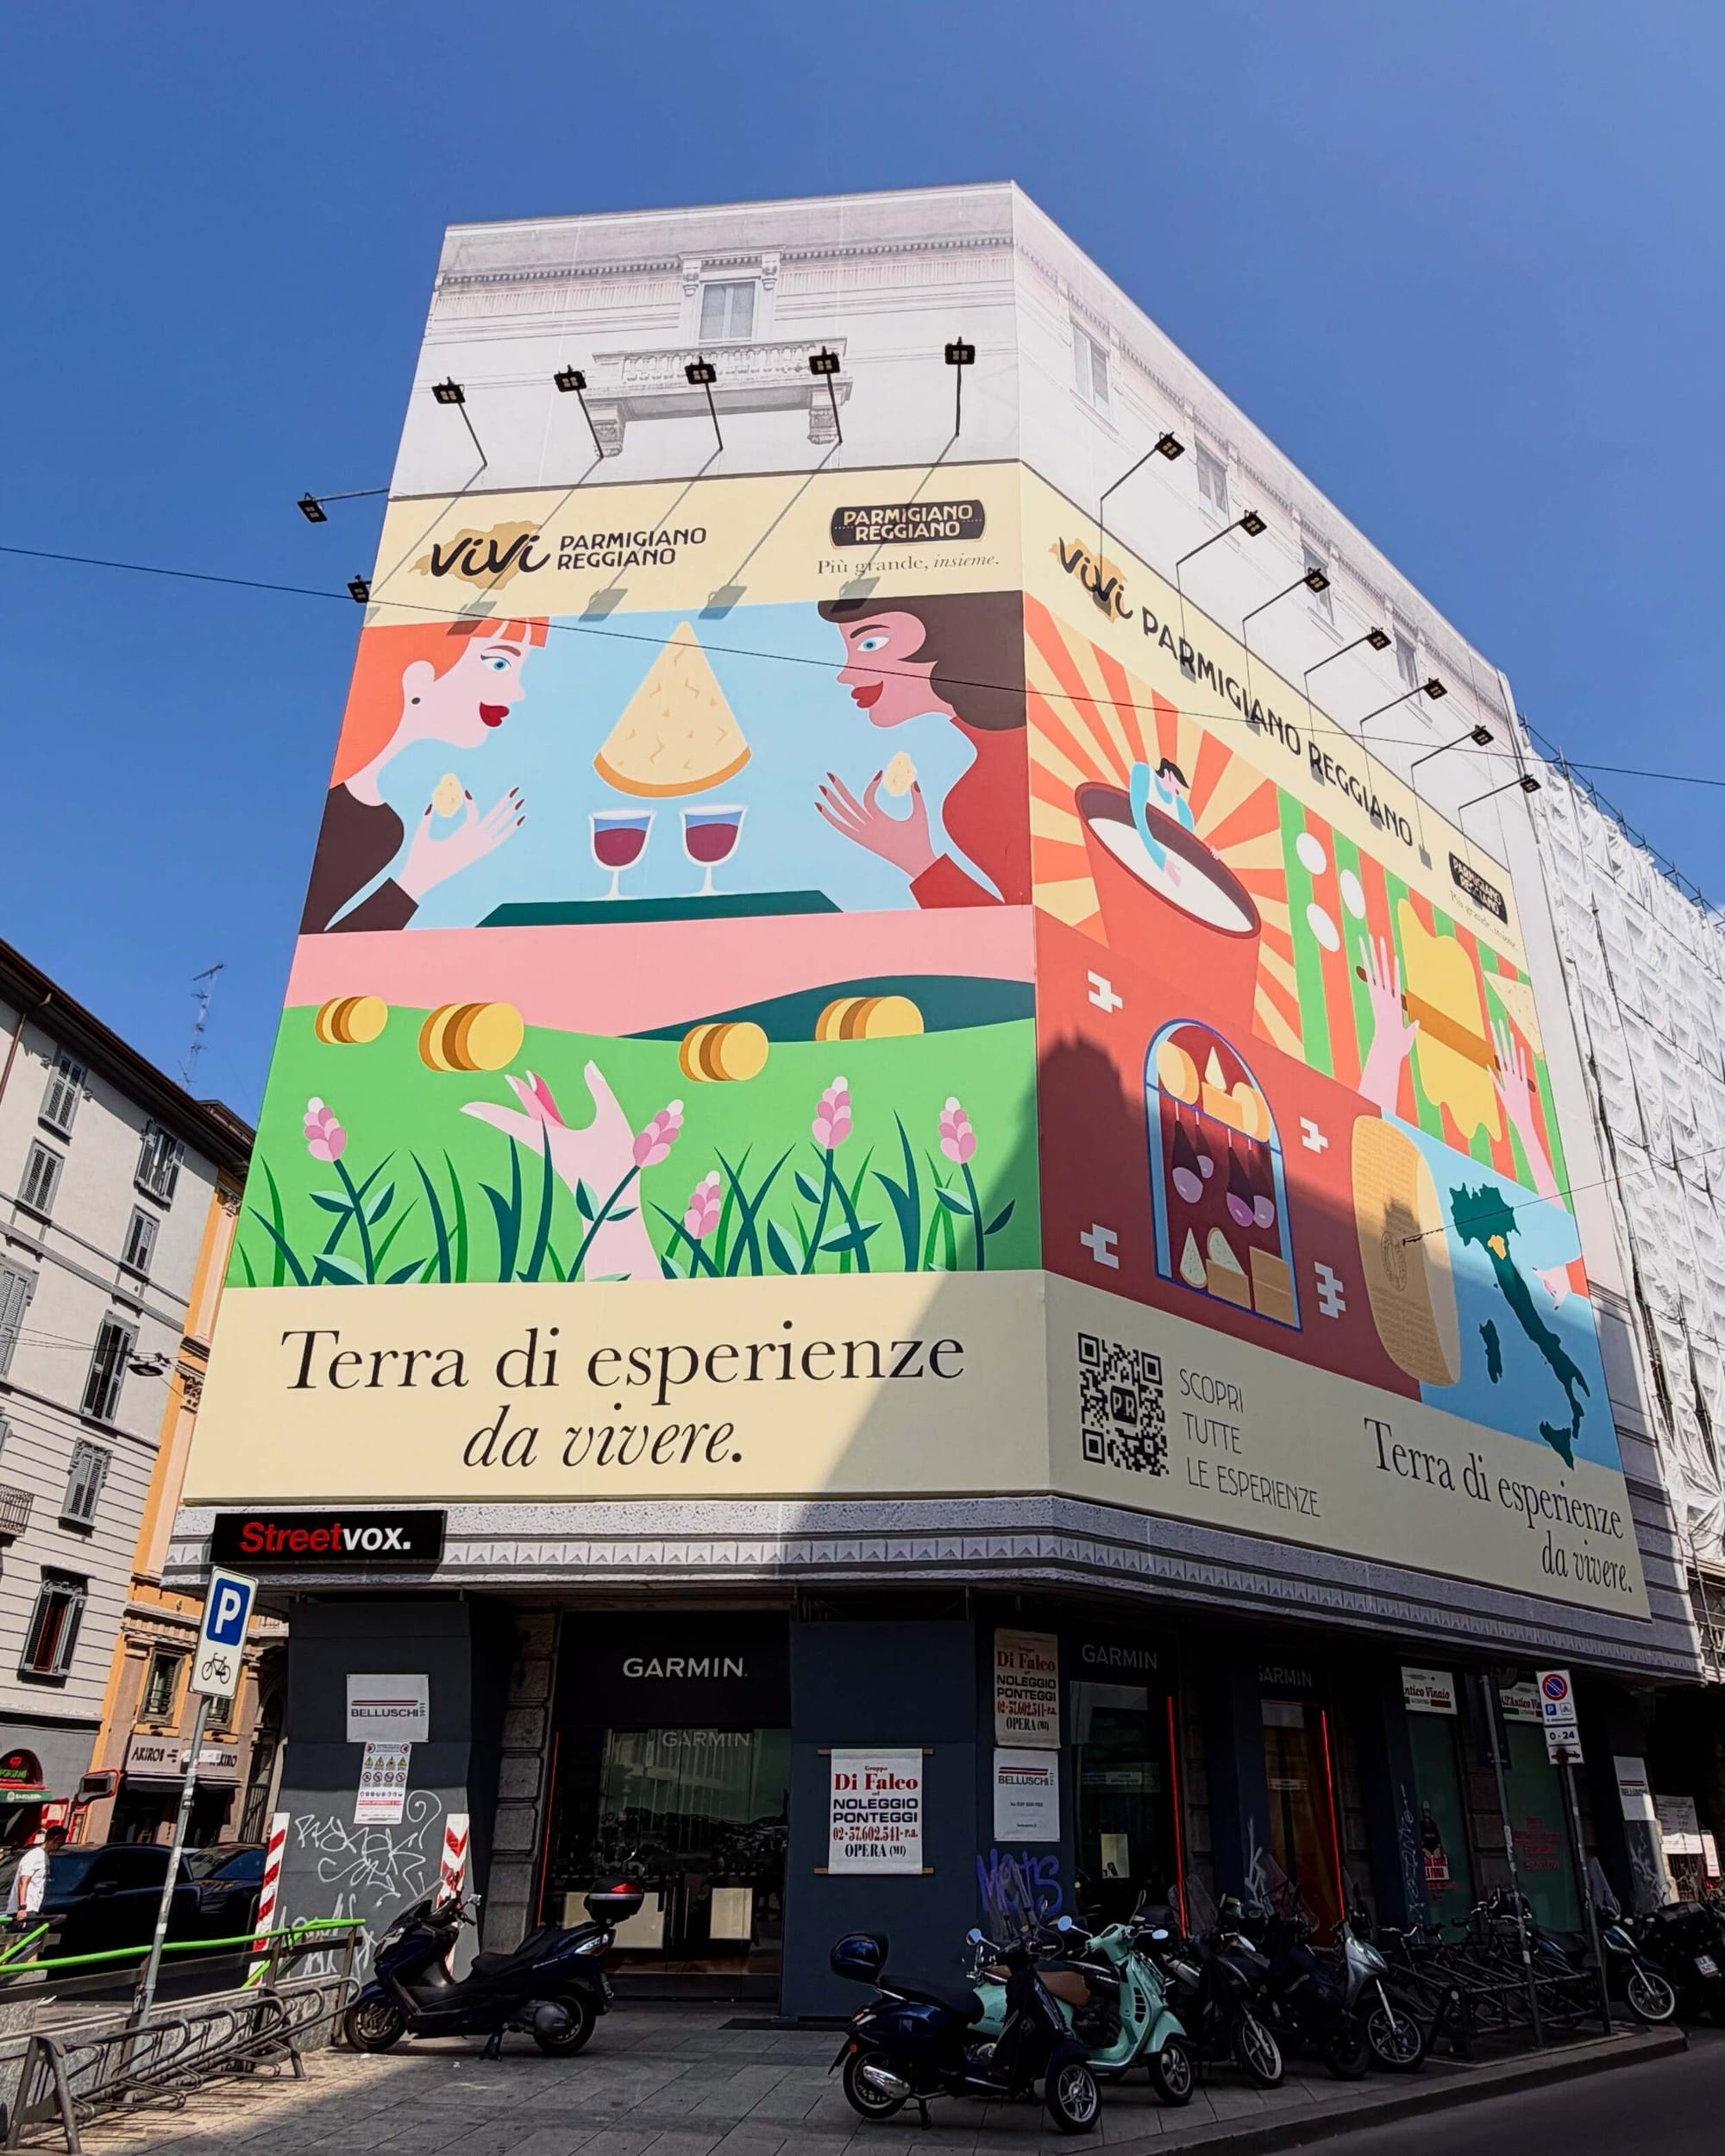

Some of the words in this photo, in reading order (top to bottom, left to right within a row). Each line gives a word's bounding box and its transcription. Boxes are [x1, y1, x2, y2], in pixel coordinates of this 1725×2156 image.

[843, 505, 973, 526] PARMIGIANO
[560, 527, 707, 551] PARMIGIANO
[855, 521, 961, 542] REGGIANO
[557, 548, 676, 570] REGGIANO
[817, 559, 849, 574] Più
[855, 555, 929, 576] grande,
[932, 552, 1000, 569] insieme.
[1141, 605, 1301, 755] PARMIGIANO
[1308, 740, 1414, 847] REGGIANO
[280, 1329, 469, 1390] Terra
[495, 1326, 558, 1389] di
[586, 1320, 966, 1407] esperienze
[1179, 1368, 1244, 1414] SCOPRI
[462, 1404, 538, 1469] da
[563, 1402, 744, 1468] vivere.
[1182, 1411, 1243, 1455] TUTTE
[1187, 1457, 1210, 1489] LE
[1217, 1465, 1321, 1518] ESPERIENZE
[1364, 1417, 1456, 1492] Terra
[1463, 1452, 1492, 1502] di
[1498, 1480, 1624, 1539] esperienze
[1542, 1531, 1569, 1578] da
[1573, 1539, 1634, 1594] vivere.
[214, 1587, 242, 1634] P
[997, 1651, 1014, 1669] Di
[1019, 1652, 1055, 1671] Falco
[1082, 1643, 1158, 1670] GARMIN
[997, 1675, 1057, 1689] NOLEGGIO
[997, 1688, 1057, 1702] PONTEGGI
[351, 1708, 419, 1718] BELLUSCHI
[1006, 1716, 1036, 1732] OPERA
[835, 1773, 857, 1790] Di
[864, 1773, 919, 1790] Falco
[998, 1775, 1049, 1786] BELLUSCHI
[833, 1798, 919, 1809] NOLEGGIO
[833, 1812, 918, 1823] PONTEGGI
[844, 1843, 887, 1858] OPERA
